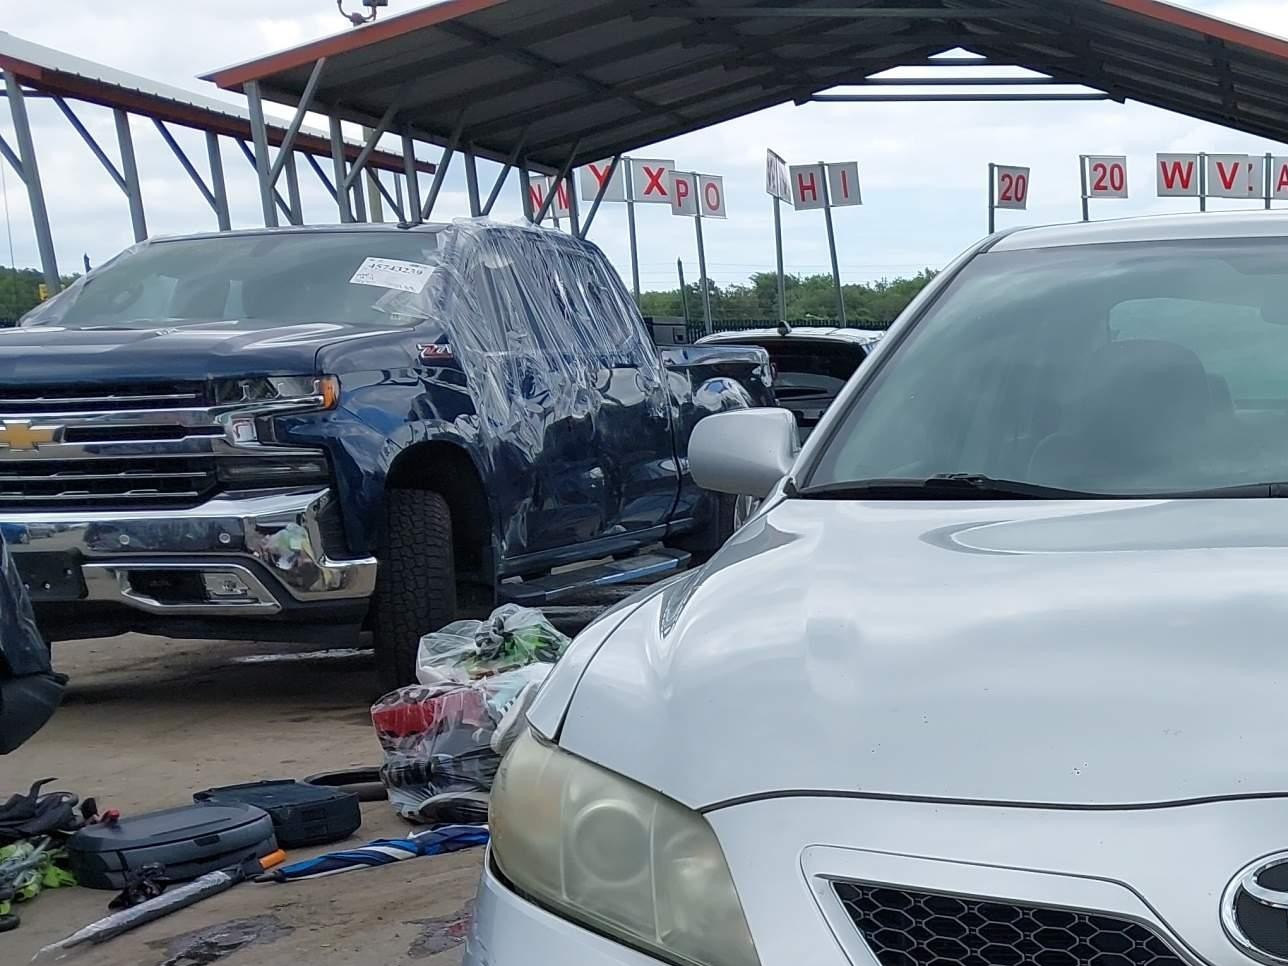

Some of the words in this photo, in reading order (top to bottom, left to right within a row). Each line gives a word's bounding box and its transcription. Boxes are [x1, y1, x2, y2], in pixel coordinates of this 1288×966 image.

[643, 166, 668, 197] X
[797, 172, 817, 202] H
[842, 170, 848, 198] I
[1000, 173, 1026, 202] 20
[1092, 162, 1125, 192] 20
[1160, 160, 1194, 191] W
[1215, 161, 1240, 190] V
[675, 179, 689, 208] P
